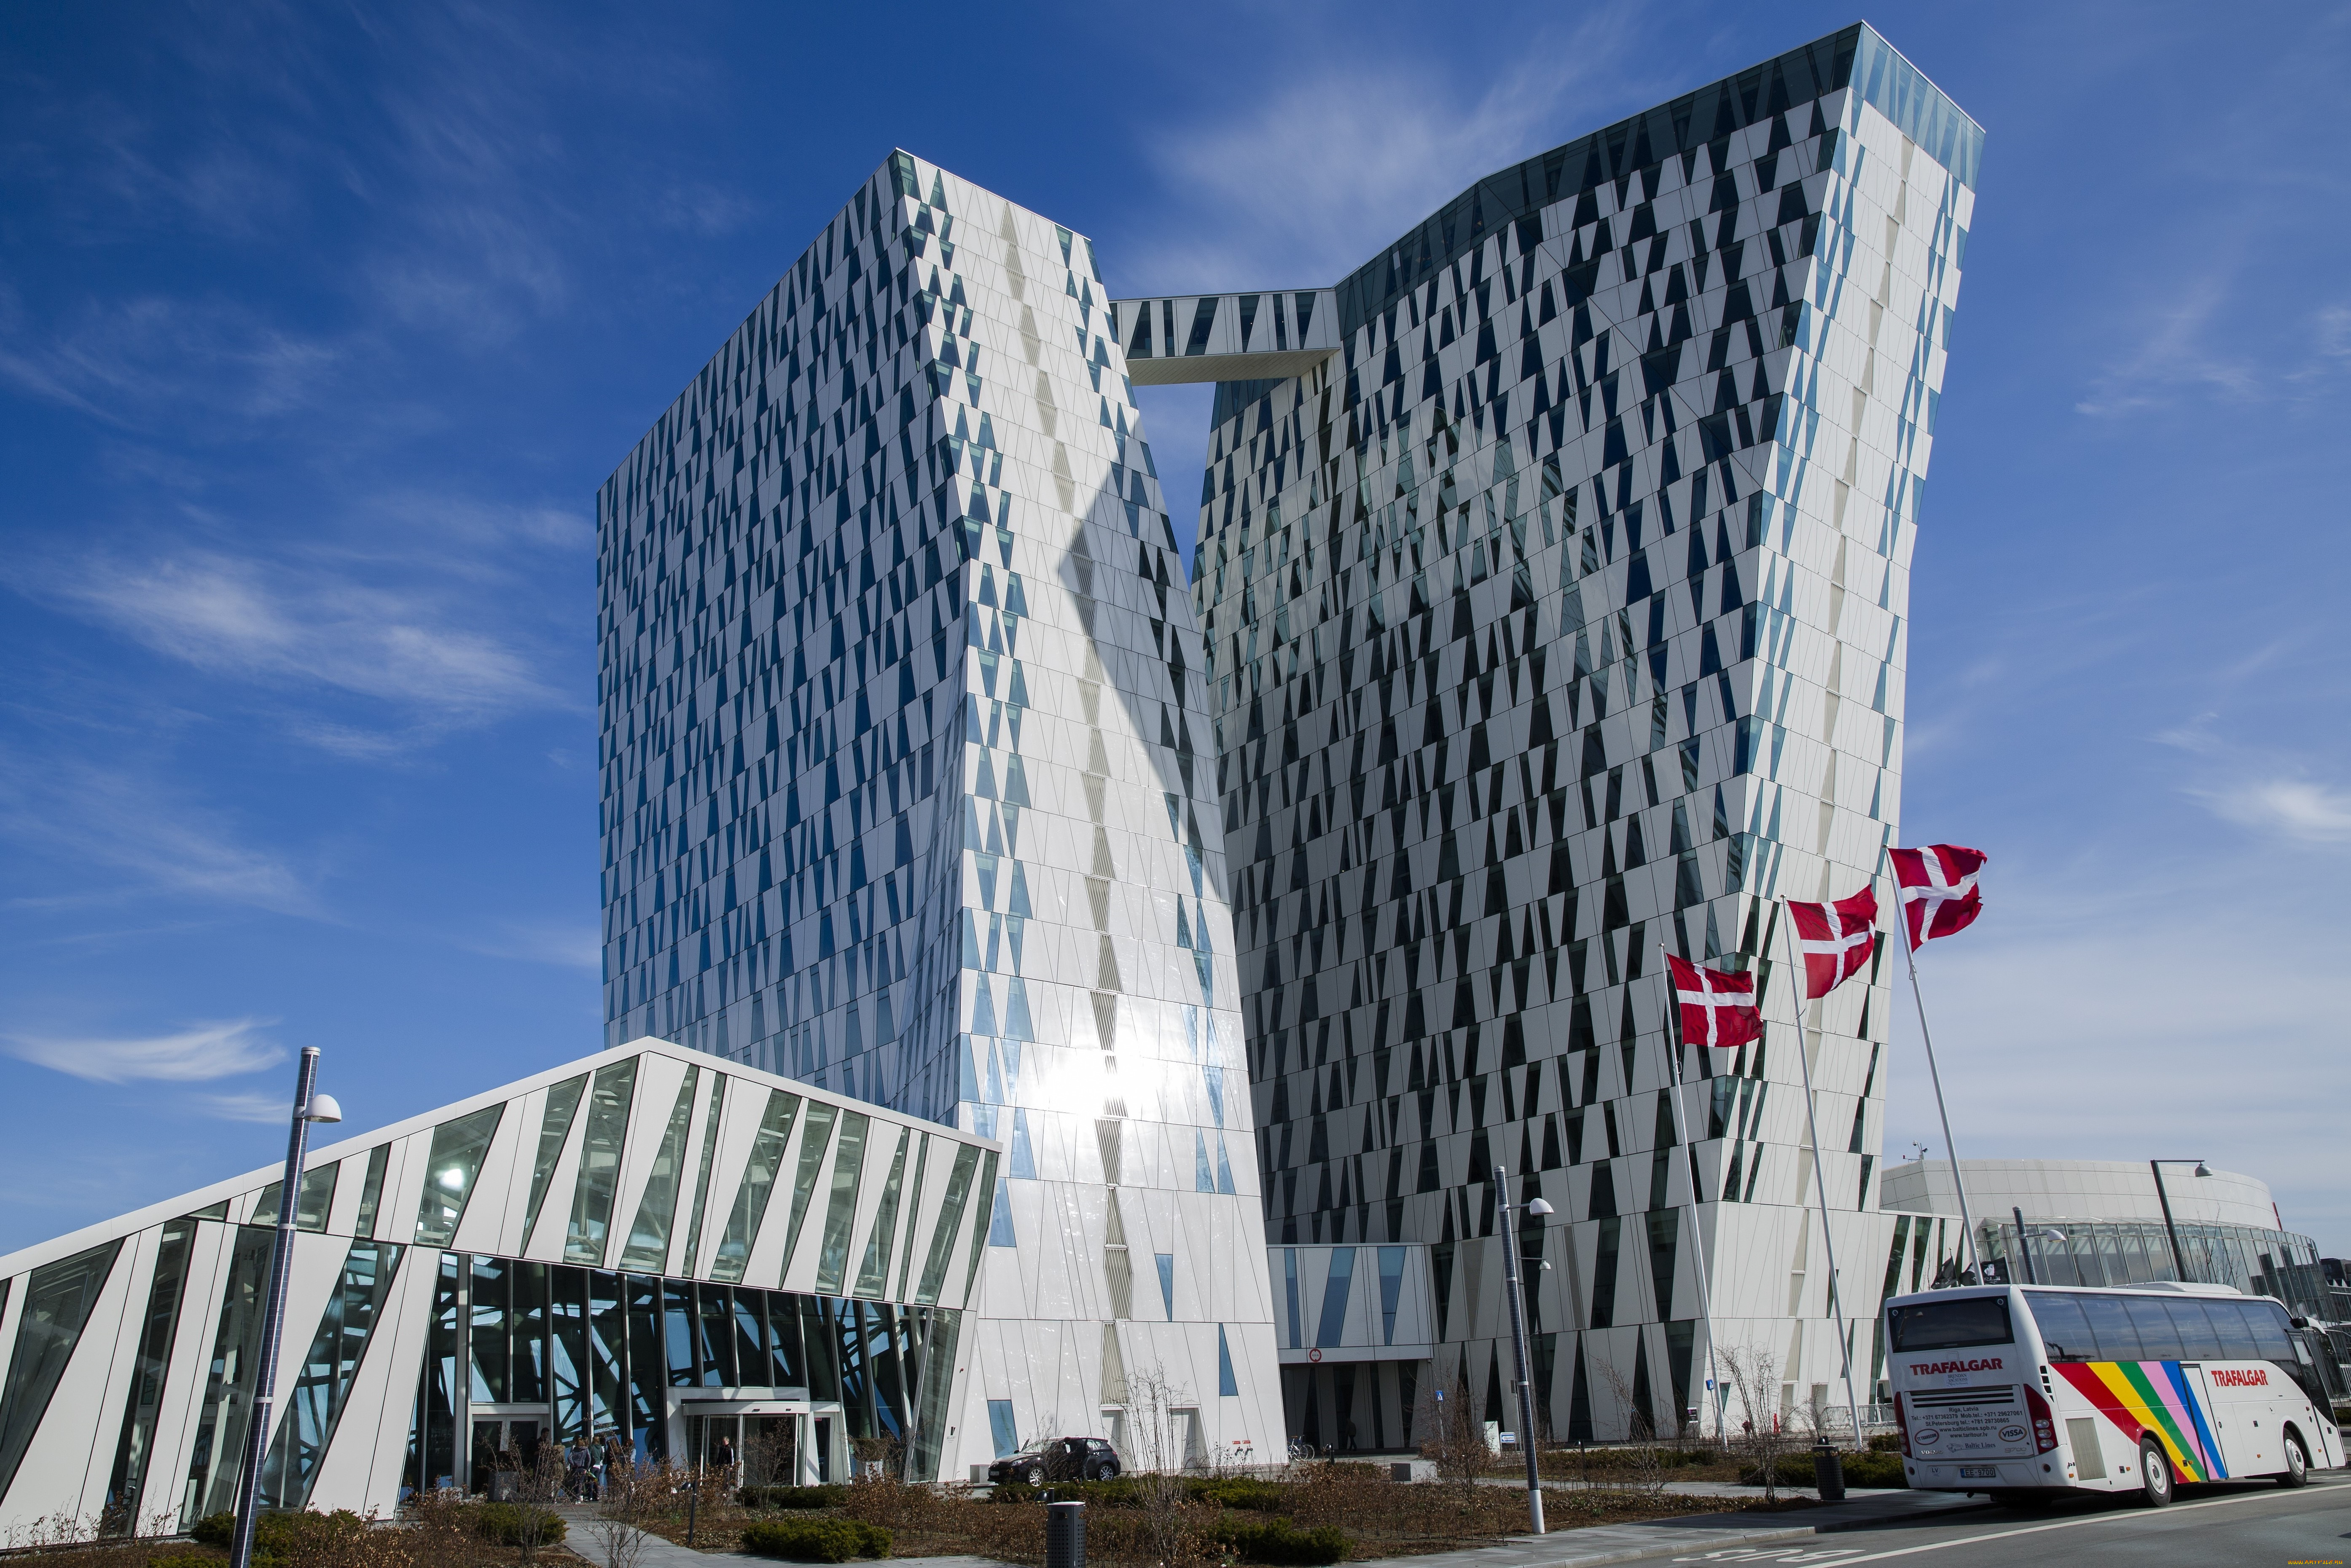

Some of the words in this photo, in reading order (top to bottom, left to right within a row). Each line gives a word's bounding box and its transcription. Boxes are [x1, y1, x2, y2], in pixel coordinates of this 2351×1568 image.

[1910, 1358, 2003, 1375] TRAFALGAR
[2211, 1370, 2268, 1386] TRAFALGAR
[2002, 1428, 2023, 1437] VISSA
